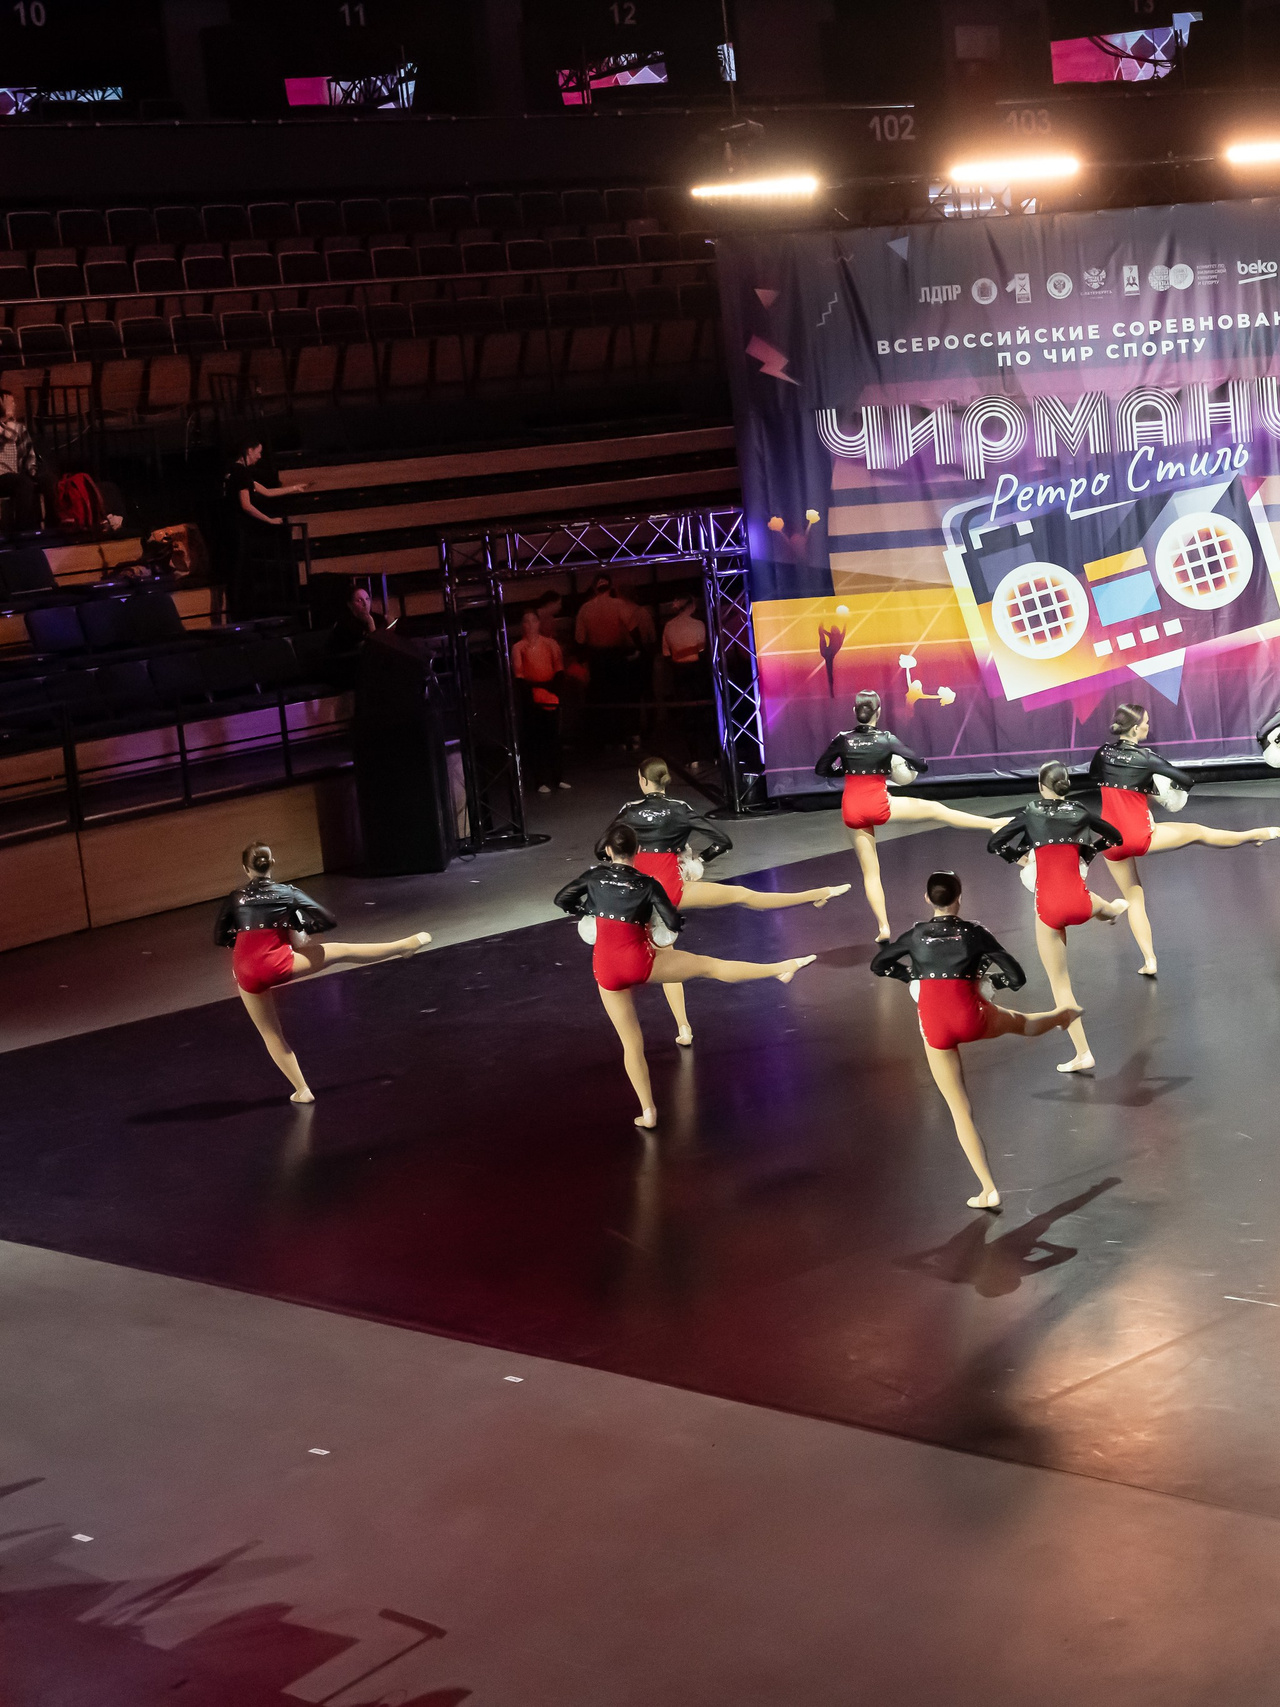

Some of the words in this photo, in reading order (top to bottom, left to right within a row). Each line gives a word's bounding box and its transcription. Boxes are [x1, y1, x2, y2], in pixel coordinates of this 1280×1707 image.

[13, 0, 46, 27] 10
[339, 3, 366, 26] 11
[609, 2, 637, 25] 12
[869, 114, 917, 141] 102
[1236, 259, 1278, 275] beko
[918, 284, 962, 304] ЛДПР
[877, 325, 1100, 355] ВСЕРОССИЙСКИЕ
[997, 351, 1032, 367] ПО
[1043, 346, 1094, 364] ЧИР
[1106, 337, 1207, 359] СПОРТУ
[990, 473, 1112, 522] Ретро
[1126, 443, 1250, 493] Стиль
